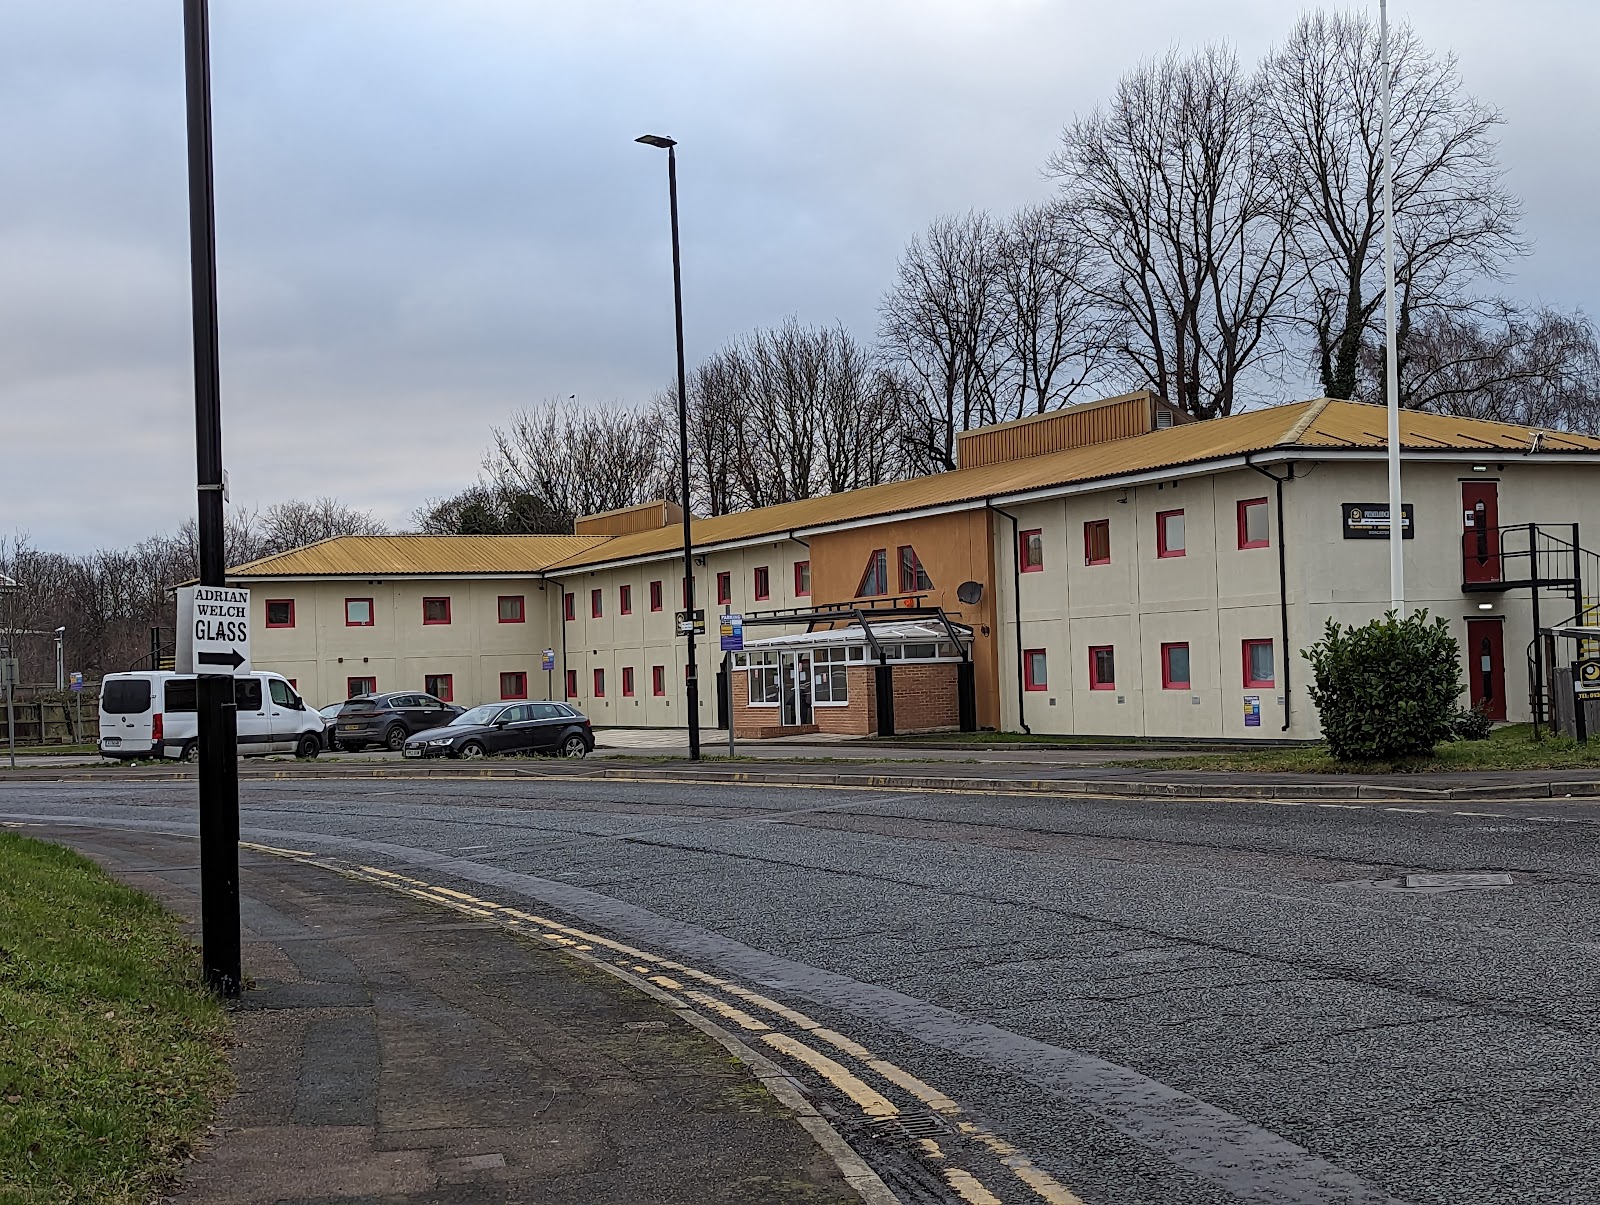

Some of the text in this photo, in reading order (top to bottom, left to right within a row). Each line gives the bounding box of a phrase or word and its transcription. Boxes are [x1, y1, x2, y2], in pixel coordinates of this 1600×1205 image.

[195, 590, 248, 603] ADRIAN
[197, 604, 246, 617] WELCH
[195, 619, 247, 642] GLASS
